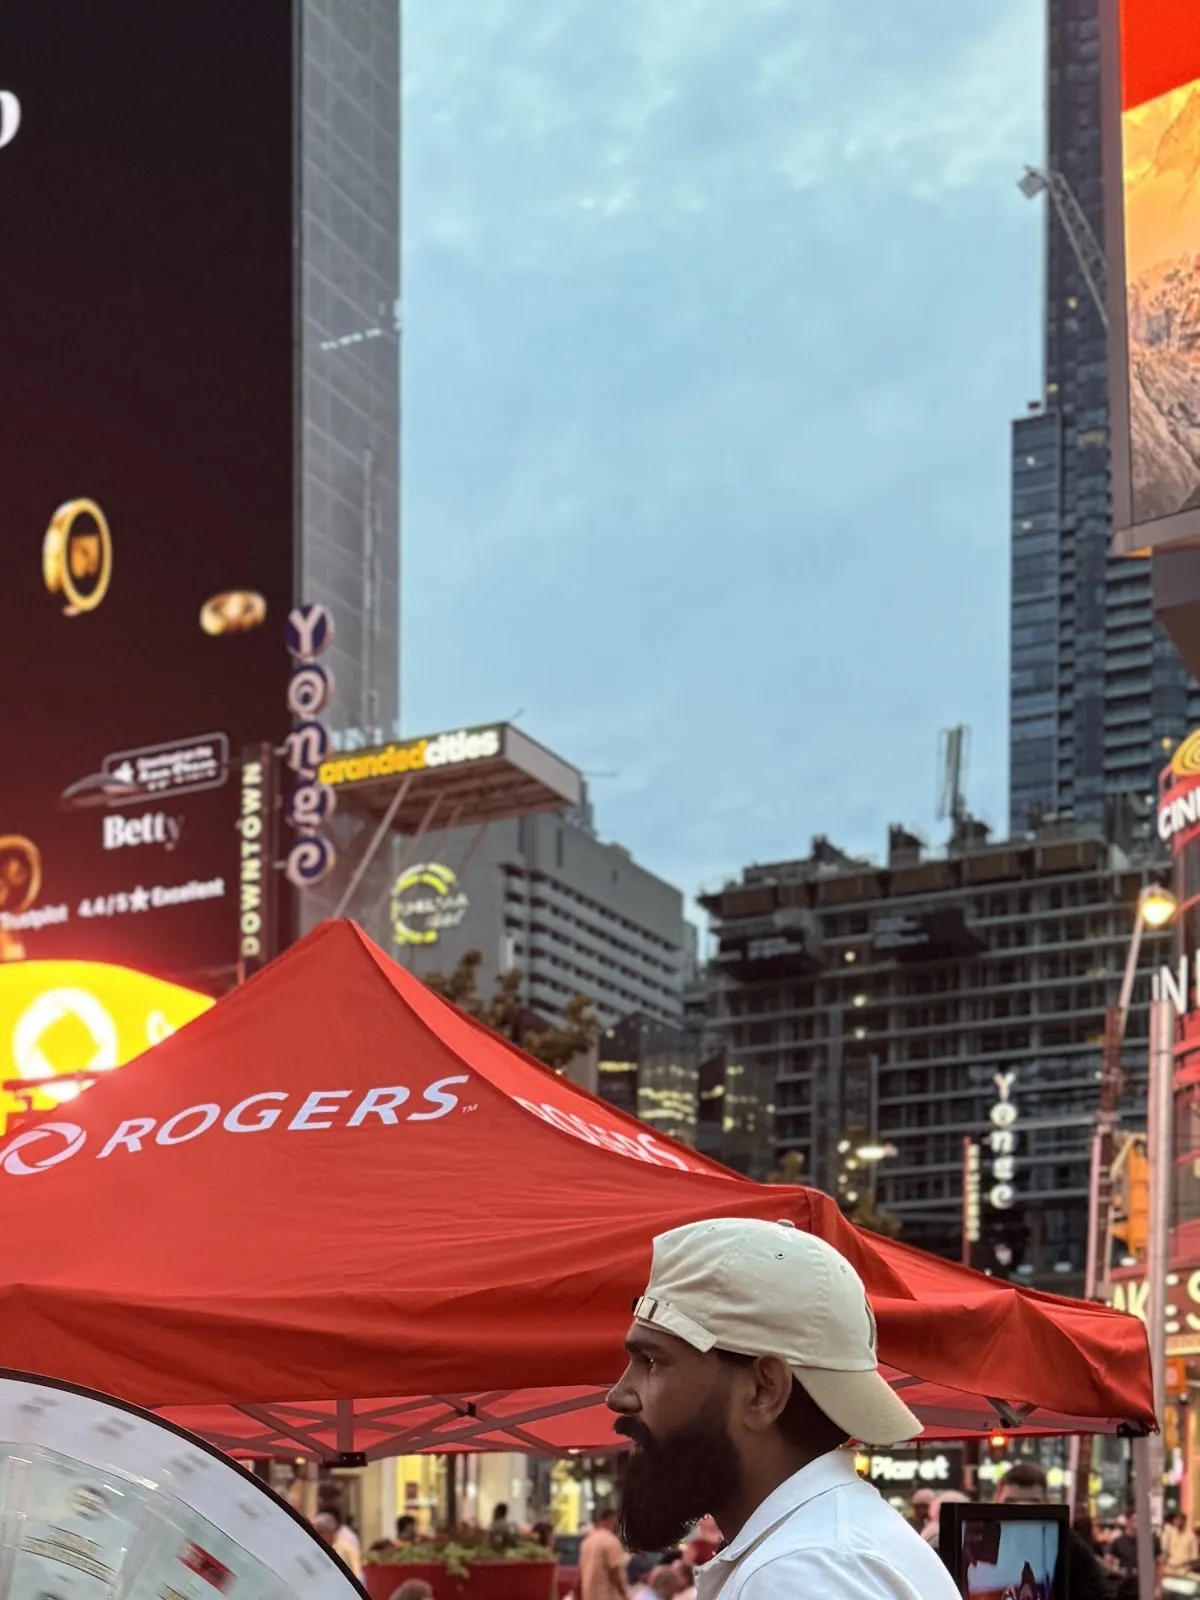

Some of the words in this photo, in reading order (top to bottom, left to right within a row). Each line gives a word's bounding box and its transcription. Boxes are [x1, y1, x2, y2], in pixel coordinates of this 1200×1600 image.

[103, 811, 185, 852] Betty
[240, 761, 263, 957] DOWNTOWN
[96, 1074, 470, 1159] ROGERS
